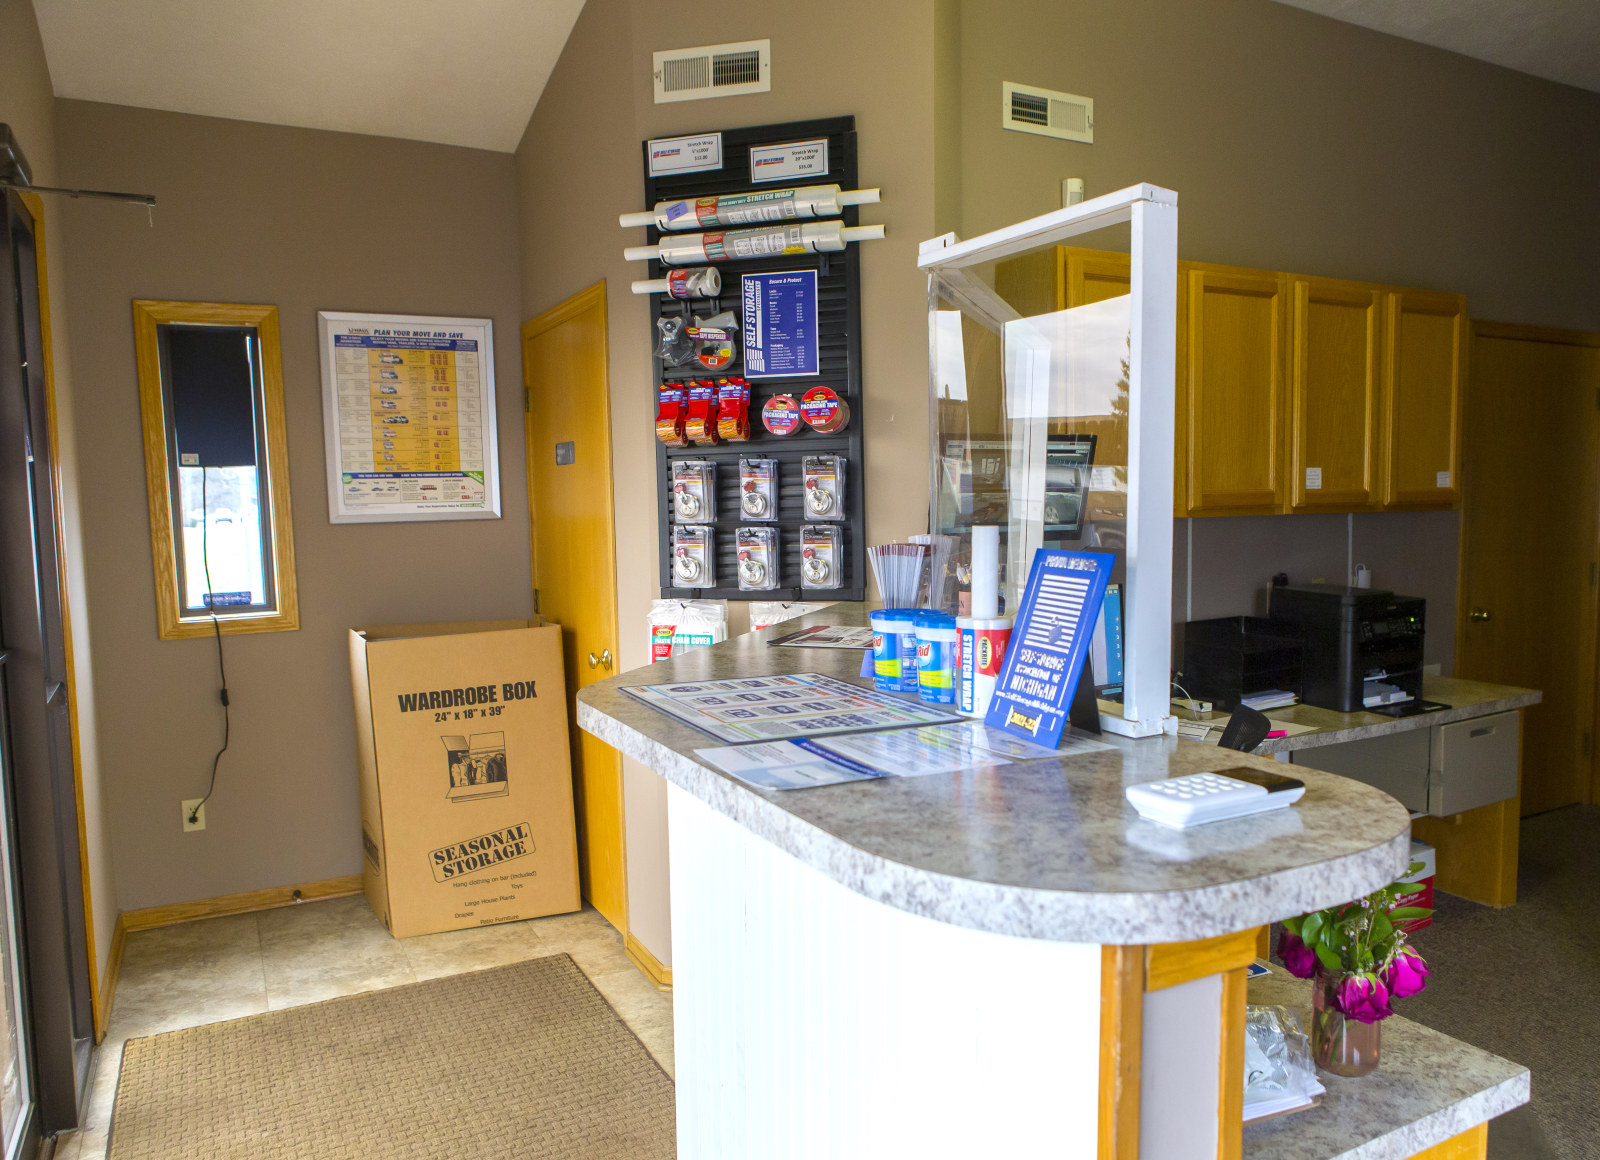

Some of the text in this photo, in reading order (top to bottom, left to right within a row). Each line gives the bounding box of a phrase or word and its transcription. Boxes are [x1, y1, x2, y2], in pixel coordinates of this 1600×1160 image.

[746, 193, 774, 202] STRETCH
[745, 279, 755, 347] SELF STORAGE
[672, 636, 690, 644] CHAIR
[691, 637, 710, 645] COVER
[962, 634, 973, 711] STRETCH WRAP
[1052, 673, 1062, 684] OF
[1010, 674, 1058, 701] MICHIGAN
[398, 681, 537, 712] WARDROBE BOX
[434, 706, 505, 722] 24" x 18" x 39"
[434, 826, 528, 865] SEASONAL
[442, 840, 526, 878] STORAGE
[468, 877, 490, 886] clothing
[510, 870, 537, 880] (included)
[454, 911, 474, 919] Drapes
[494, 914, 519, 922] Furniture
